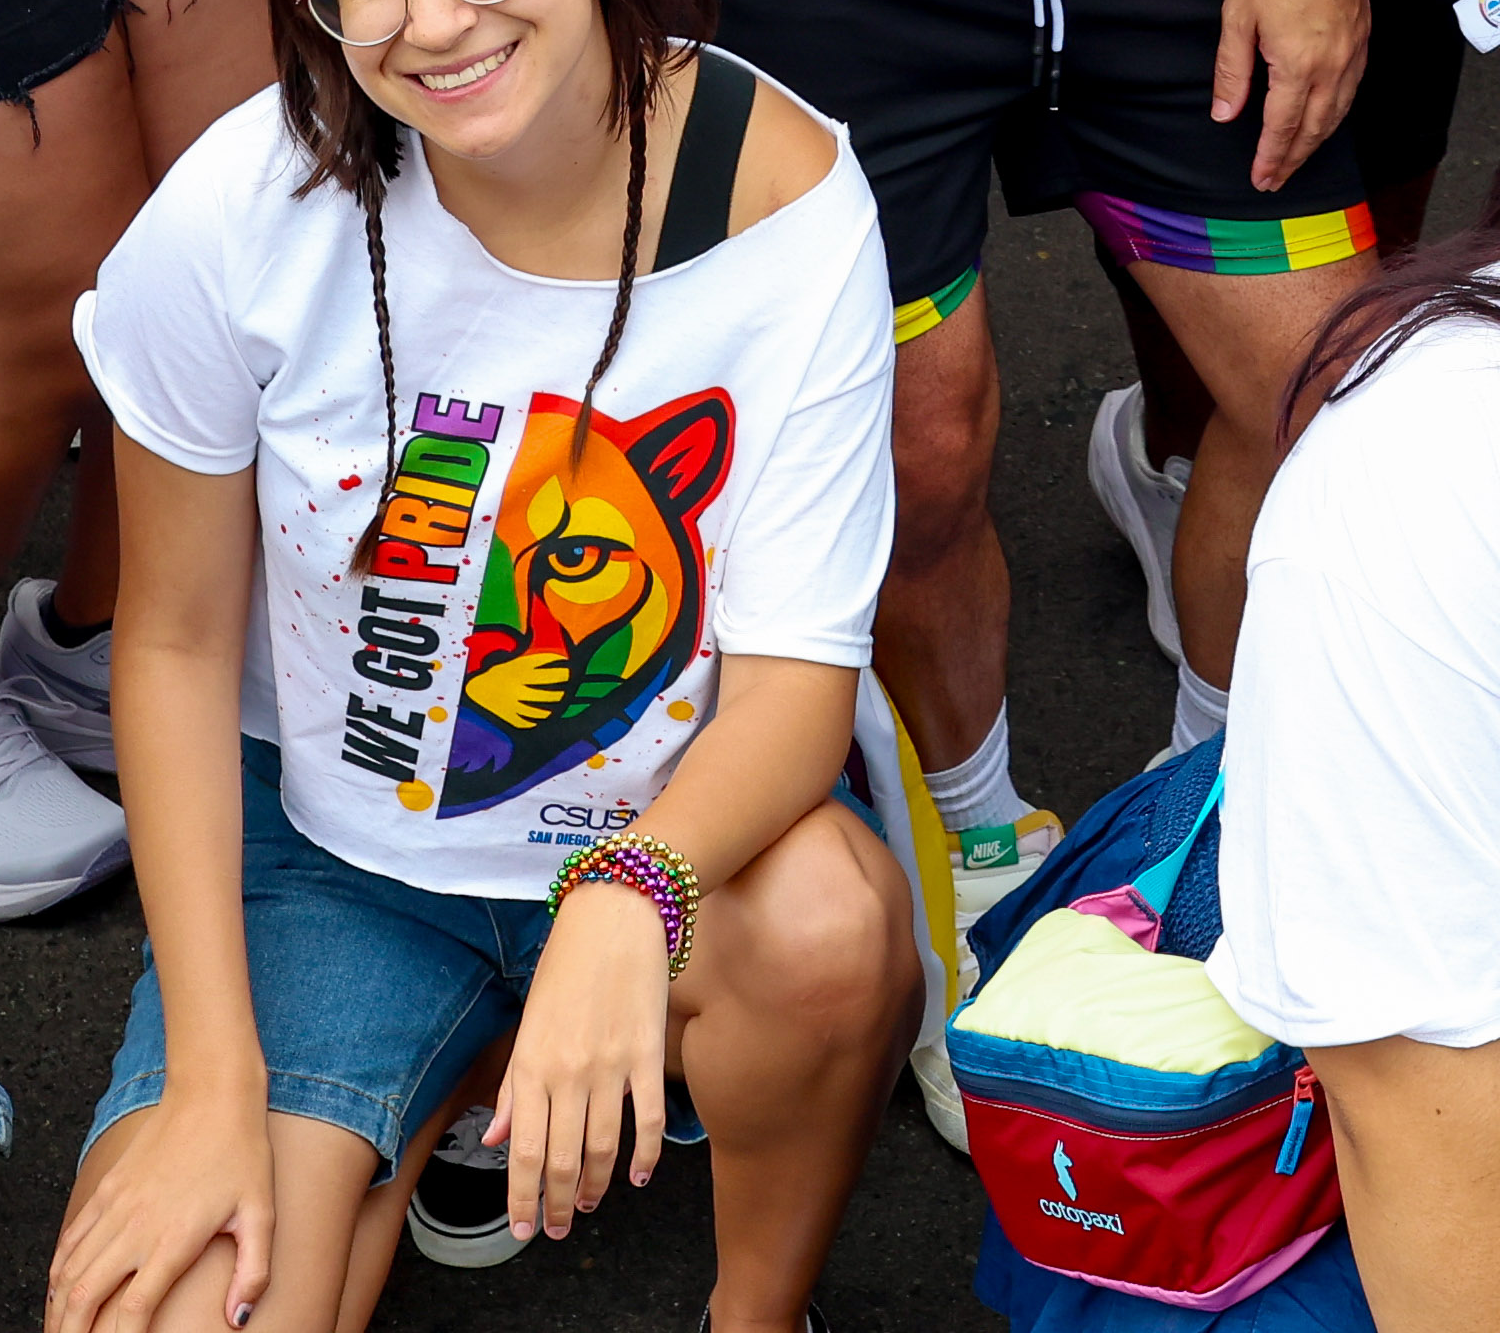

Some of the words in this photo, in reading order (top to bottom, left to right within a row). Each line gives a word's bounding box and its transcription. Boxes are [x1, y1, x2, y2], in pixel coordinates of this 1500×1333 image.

[372, 392, 504, 586] PRIDE
[352, 586, 449, 691] GOT
[341, 693, 426, 782] WE
[527, 831, 551, 845] SAN
[555, 831, 592, 847] DIEGO
[973, 840, 1002, 859] NIKE
[1040, 1198, 1126, 1235] cotopaxi
